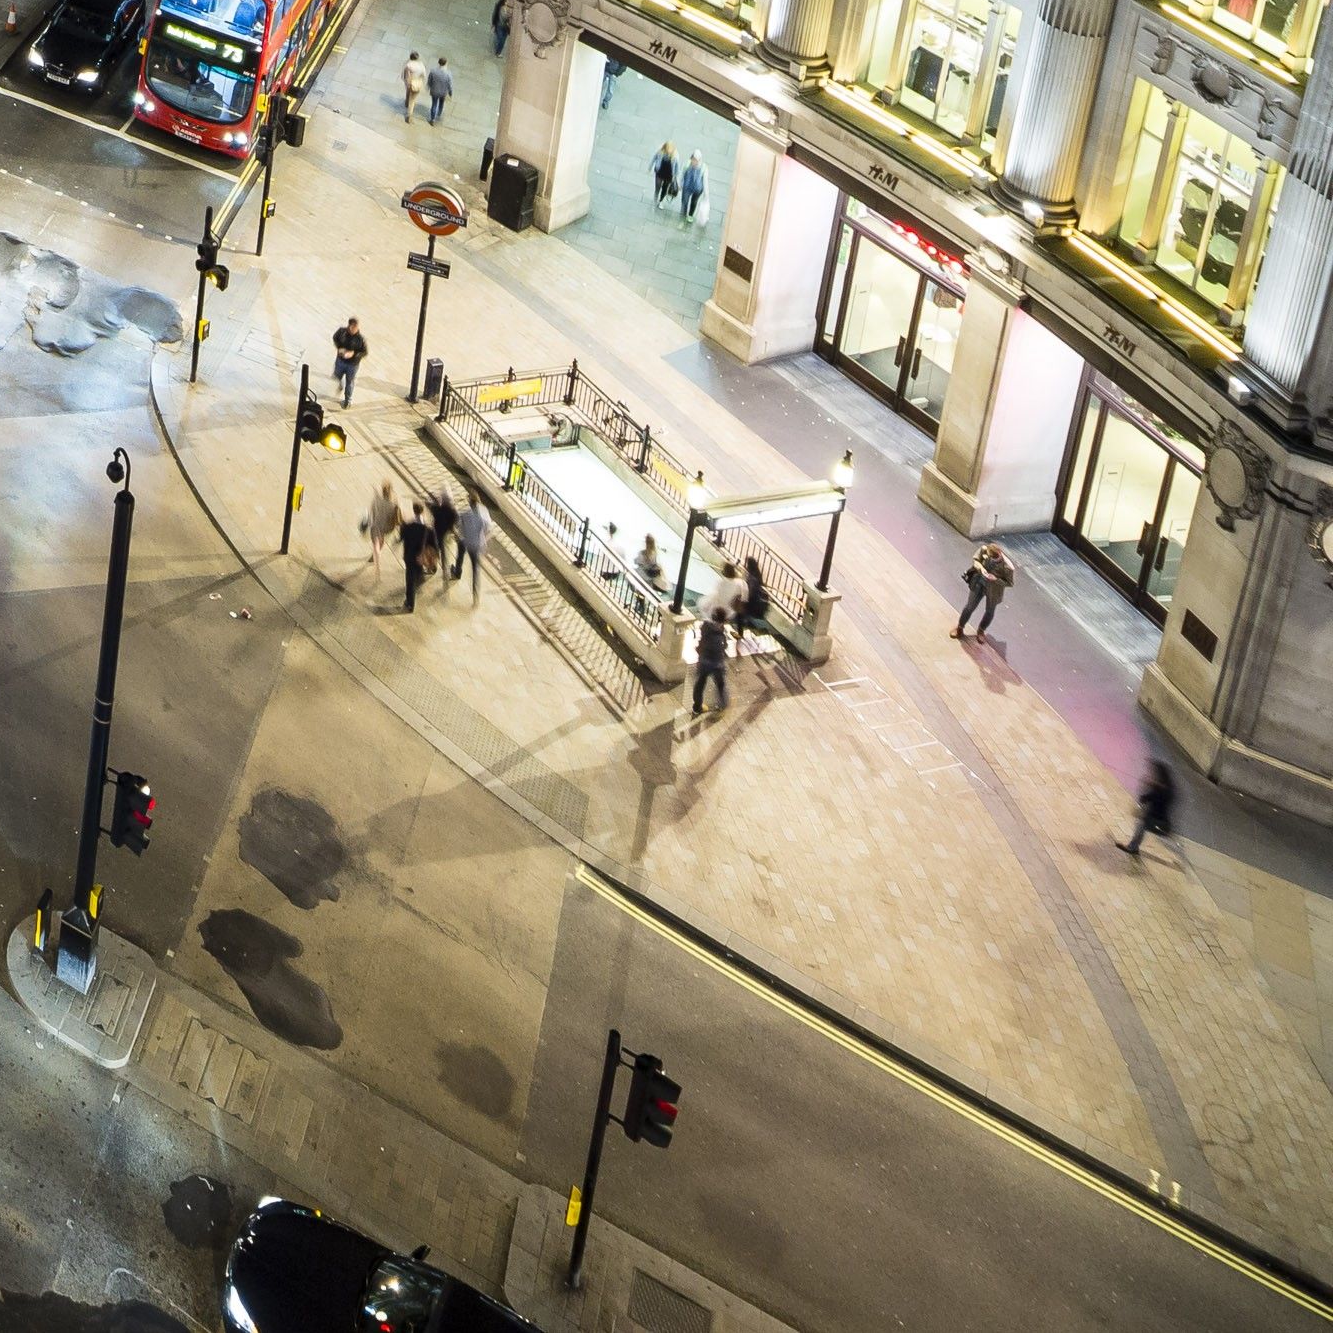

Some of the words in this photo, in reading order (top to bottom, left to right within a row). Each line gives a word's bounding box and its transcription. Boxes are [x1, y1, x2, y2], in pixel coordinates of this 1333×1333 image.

[222, 43, 244, 63] 73
[649, 39, 678, 64] H&M
[868, 164, 900, 192] H&M
[403, 201, 465, 226] UNDERGROUND
[1102, 324, 1137, 359] H&M
